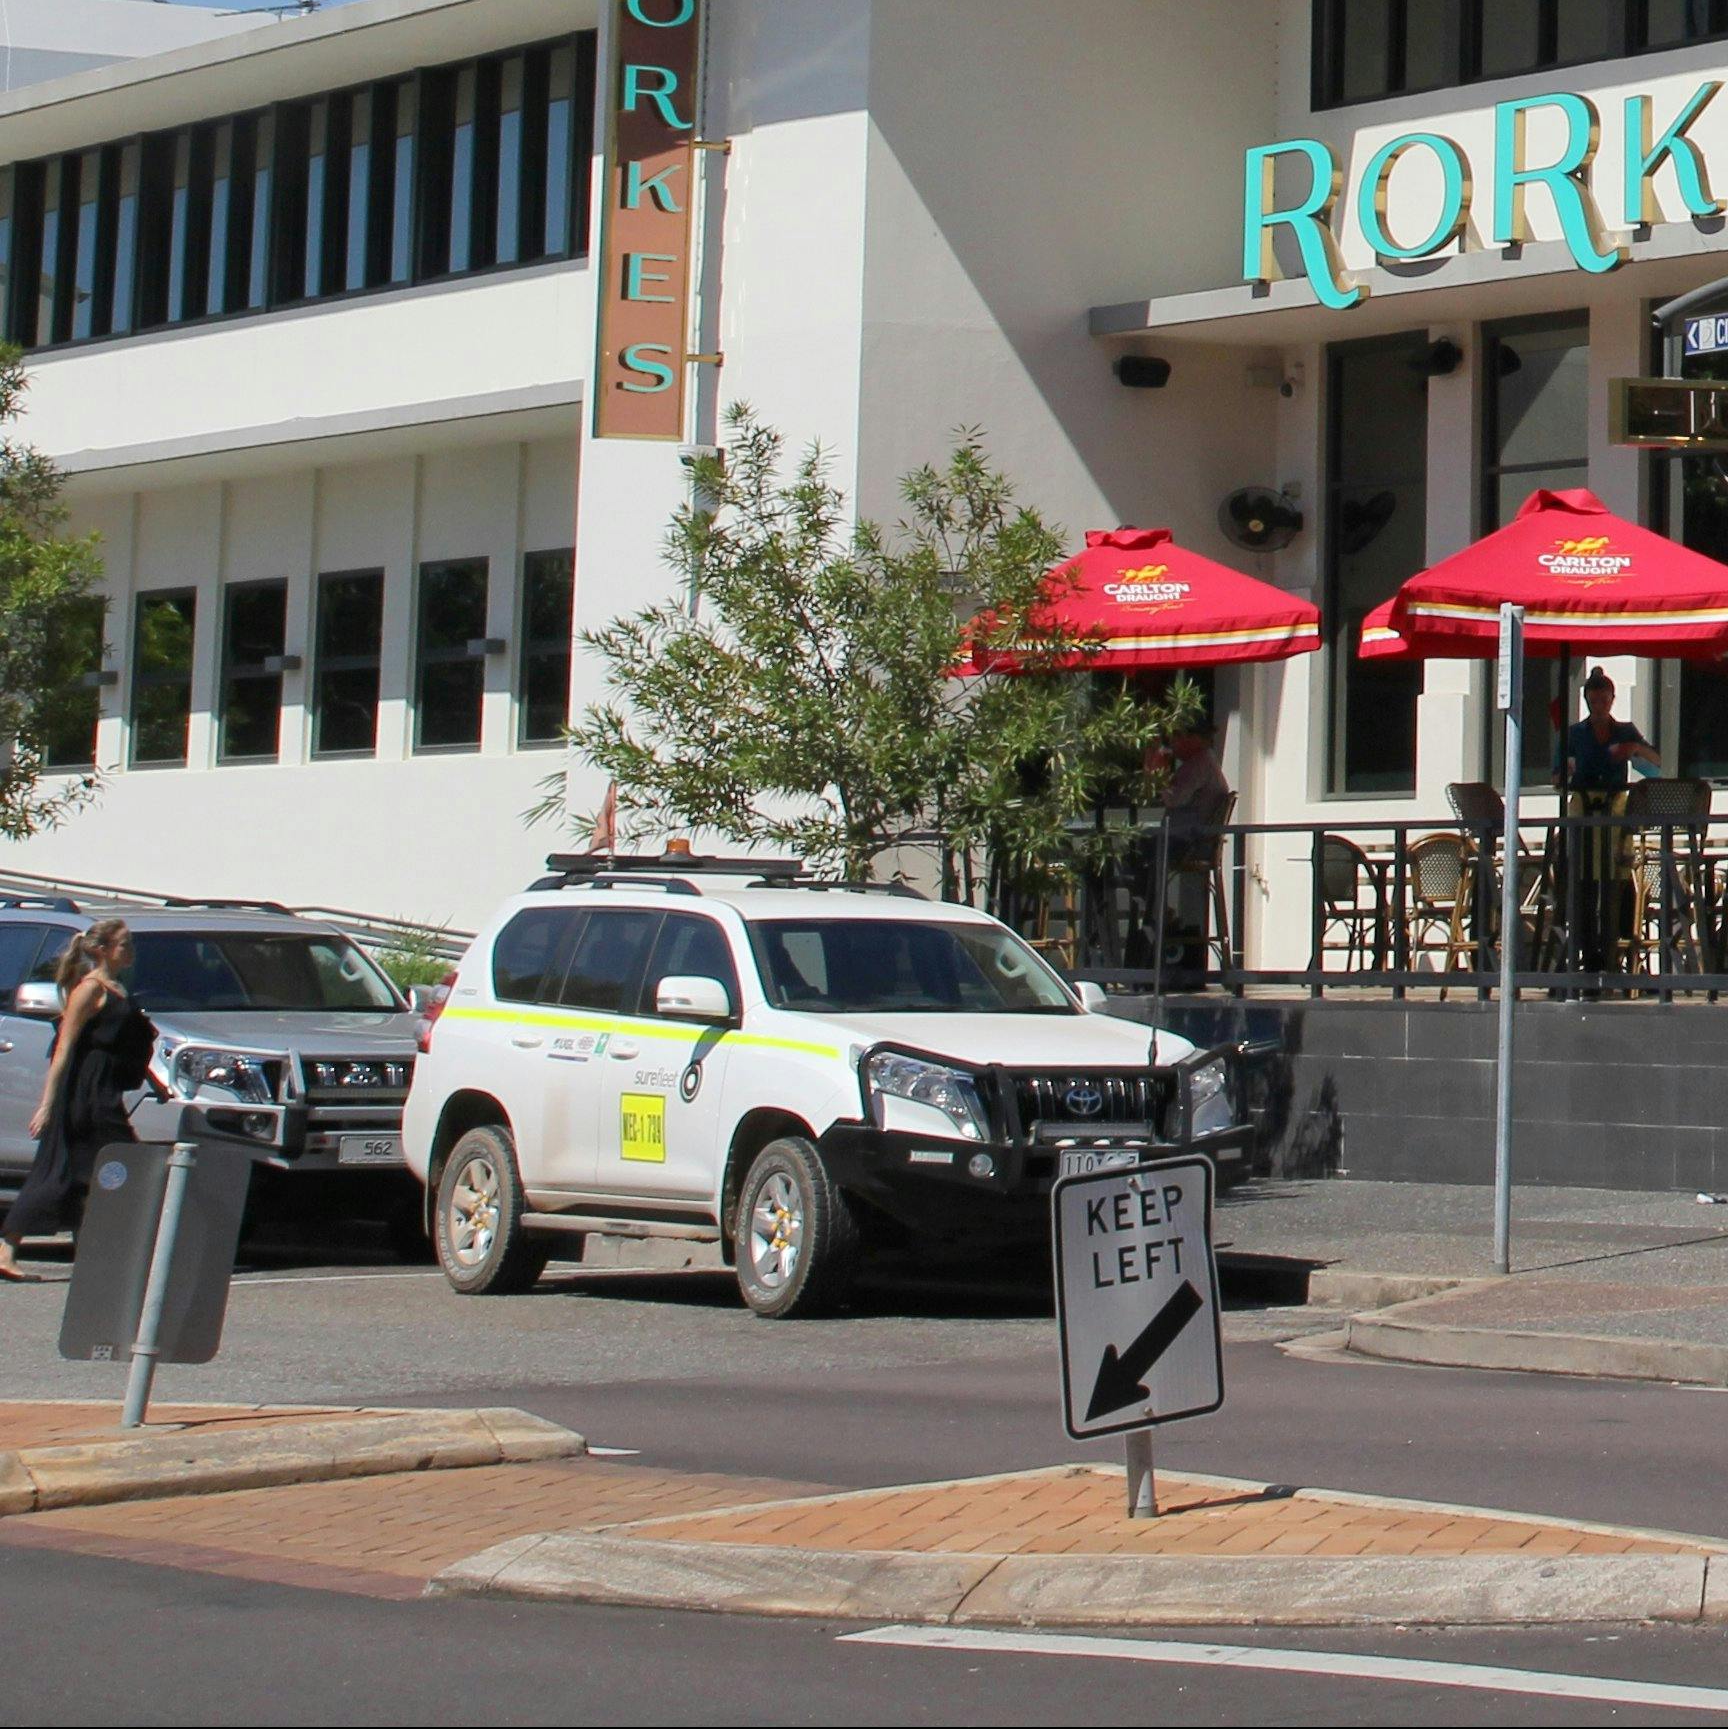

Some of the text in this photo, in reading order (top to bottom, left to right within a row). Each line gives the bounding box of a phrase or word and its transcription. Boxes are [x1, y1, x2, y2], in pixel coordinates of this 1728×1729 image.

[1537, 554, 1631, 567] CARLTON
[1550, 565, 1620, 575] DRAUGHT
[1103, 583, 1190, 595] CARLTON
[1116, 593, 1181, 602] DRAUGHT
[1087, 1185, 1183, 1236] KEEP
[1093, 1237, 1184, 1289] LEFT
